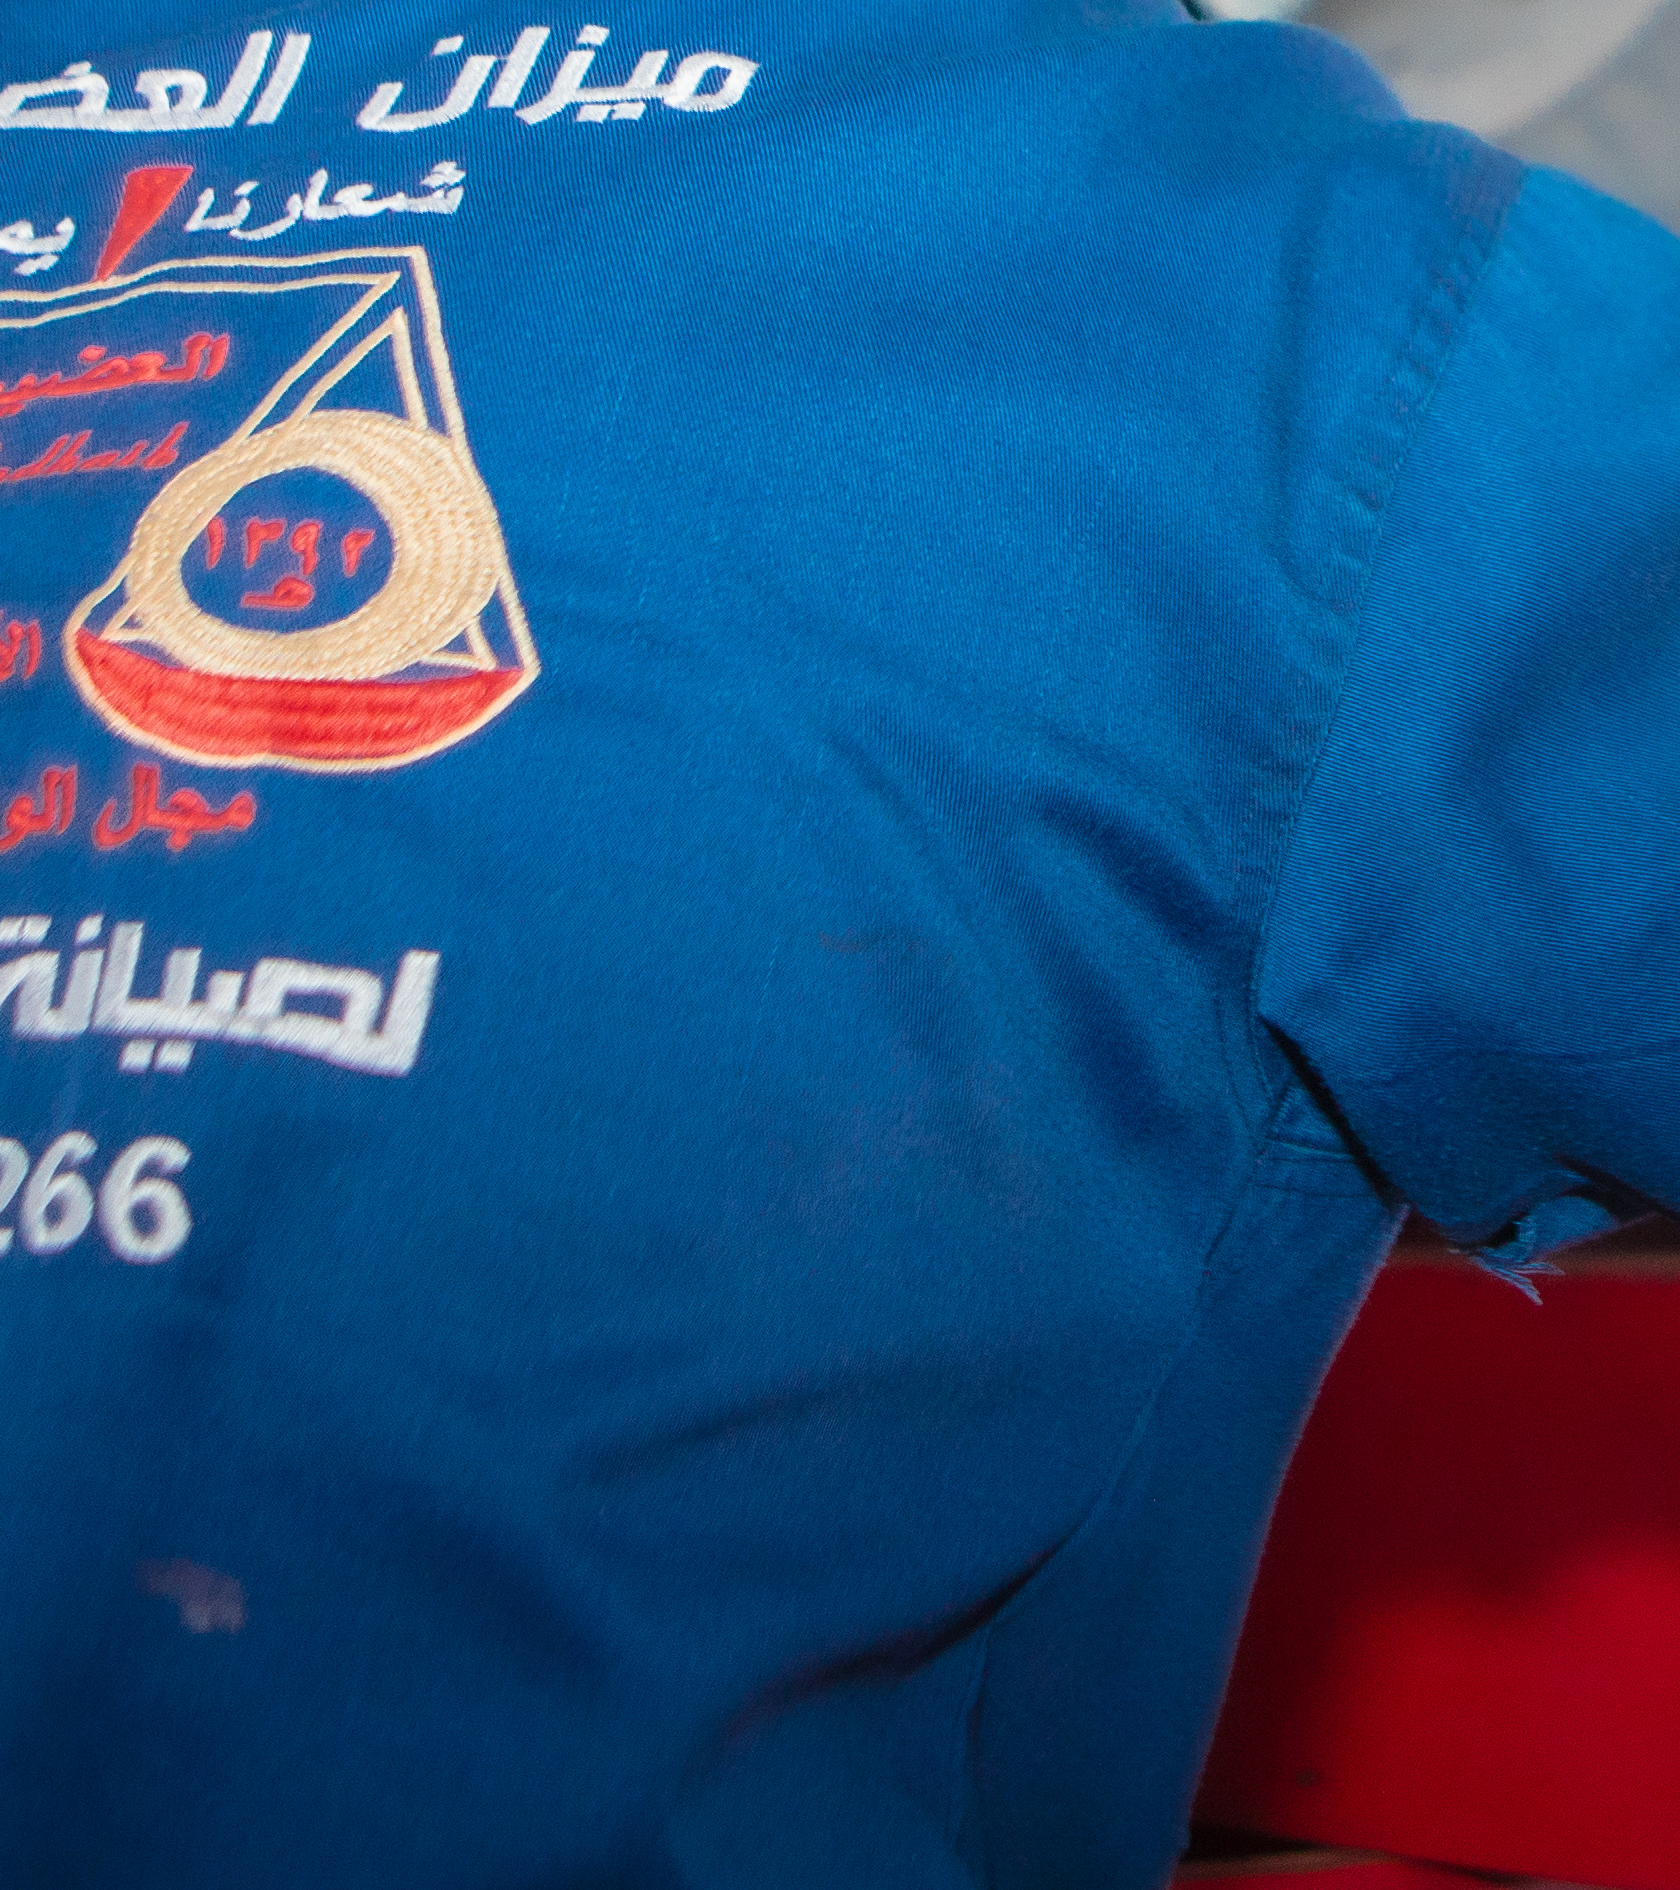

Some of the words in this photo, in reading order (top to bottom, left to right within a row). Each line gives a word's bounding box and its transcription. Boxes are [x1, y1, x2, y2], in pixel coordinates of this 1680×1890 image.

[356, 24, 760, 128] ميزان
[184, 160, 467, 241] شعارنا
[93, 761, 258, 851] مجال
